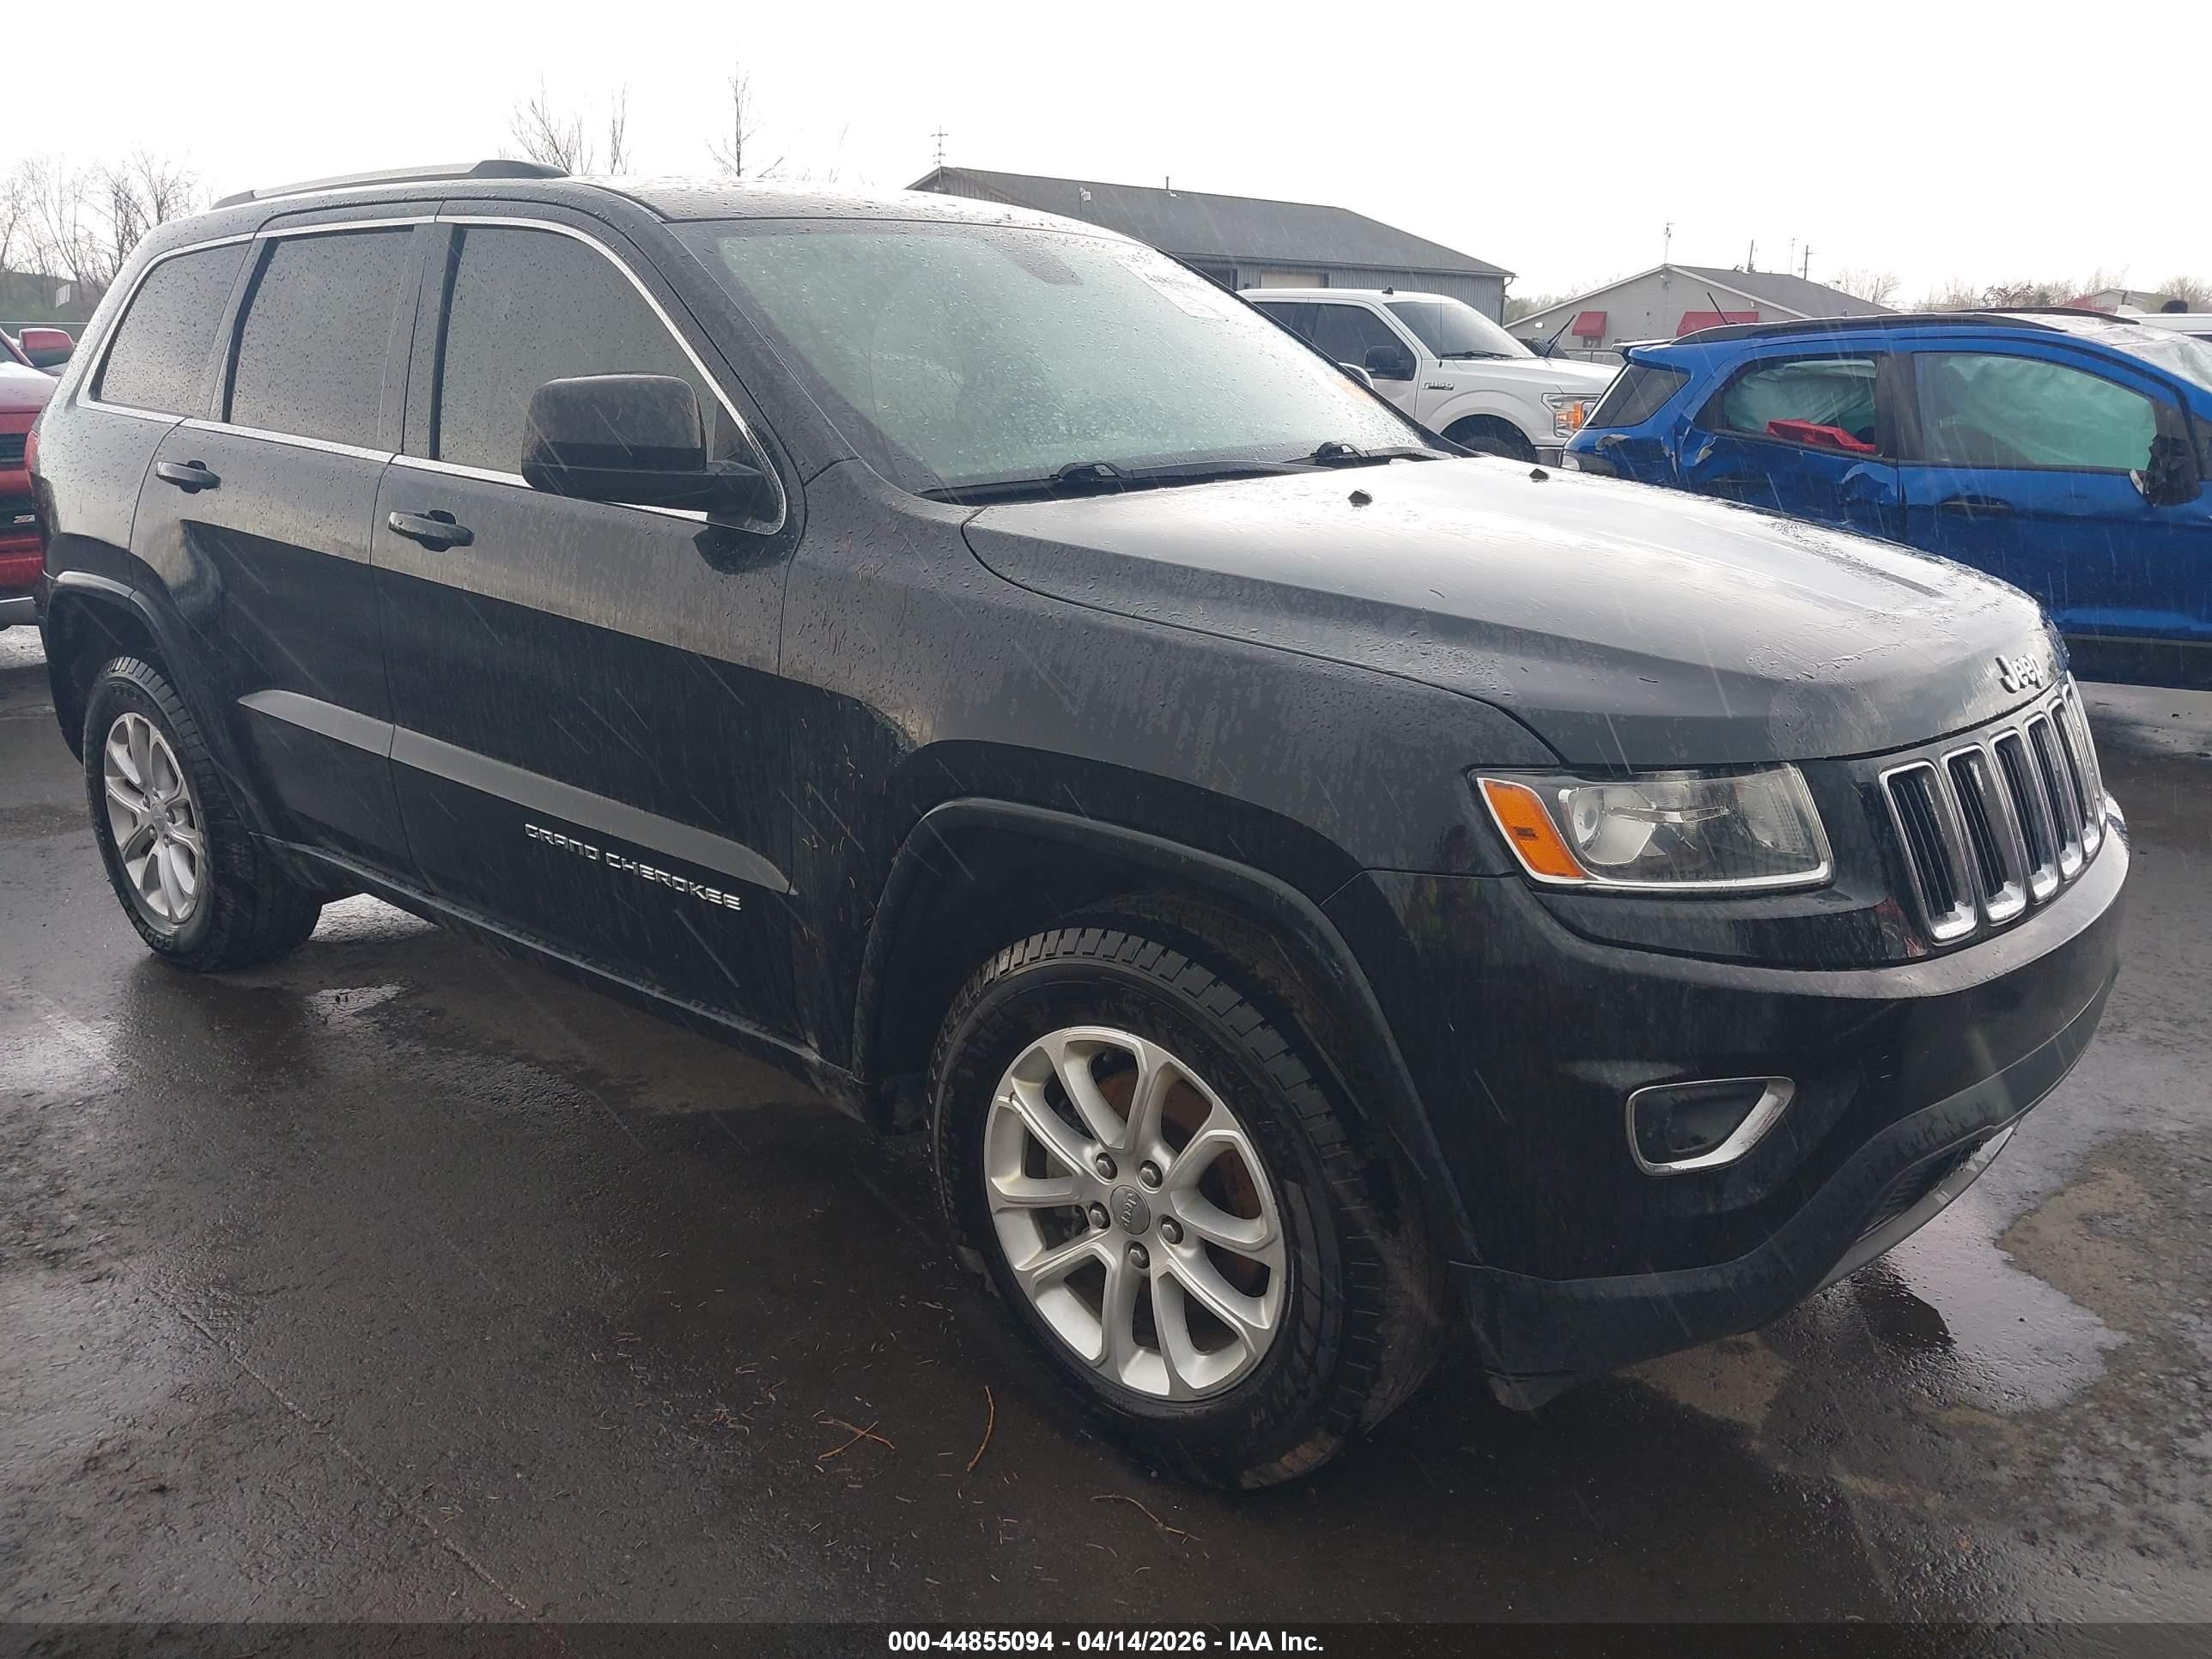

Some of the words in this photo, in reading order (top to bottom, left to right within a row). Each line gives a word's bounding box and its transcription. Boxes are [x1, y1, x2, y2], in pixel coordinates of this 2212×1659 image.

[1995, 654, 2044, 694] Jeep
[525, 823, 600, 860] GRAND
[605, 852, 741, 910] CHEROKEE
[1121, 1193, 1137, 1227] Jeep
